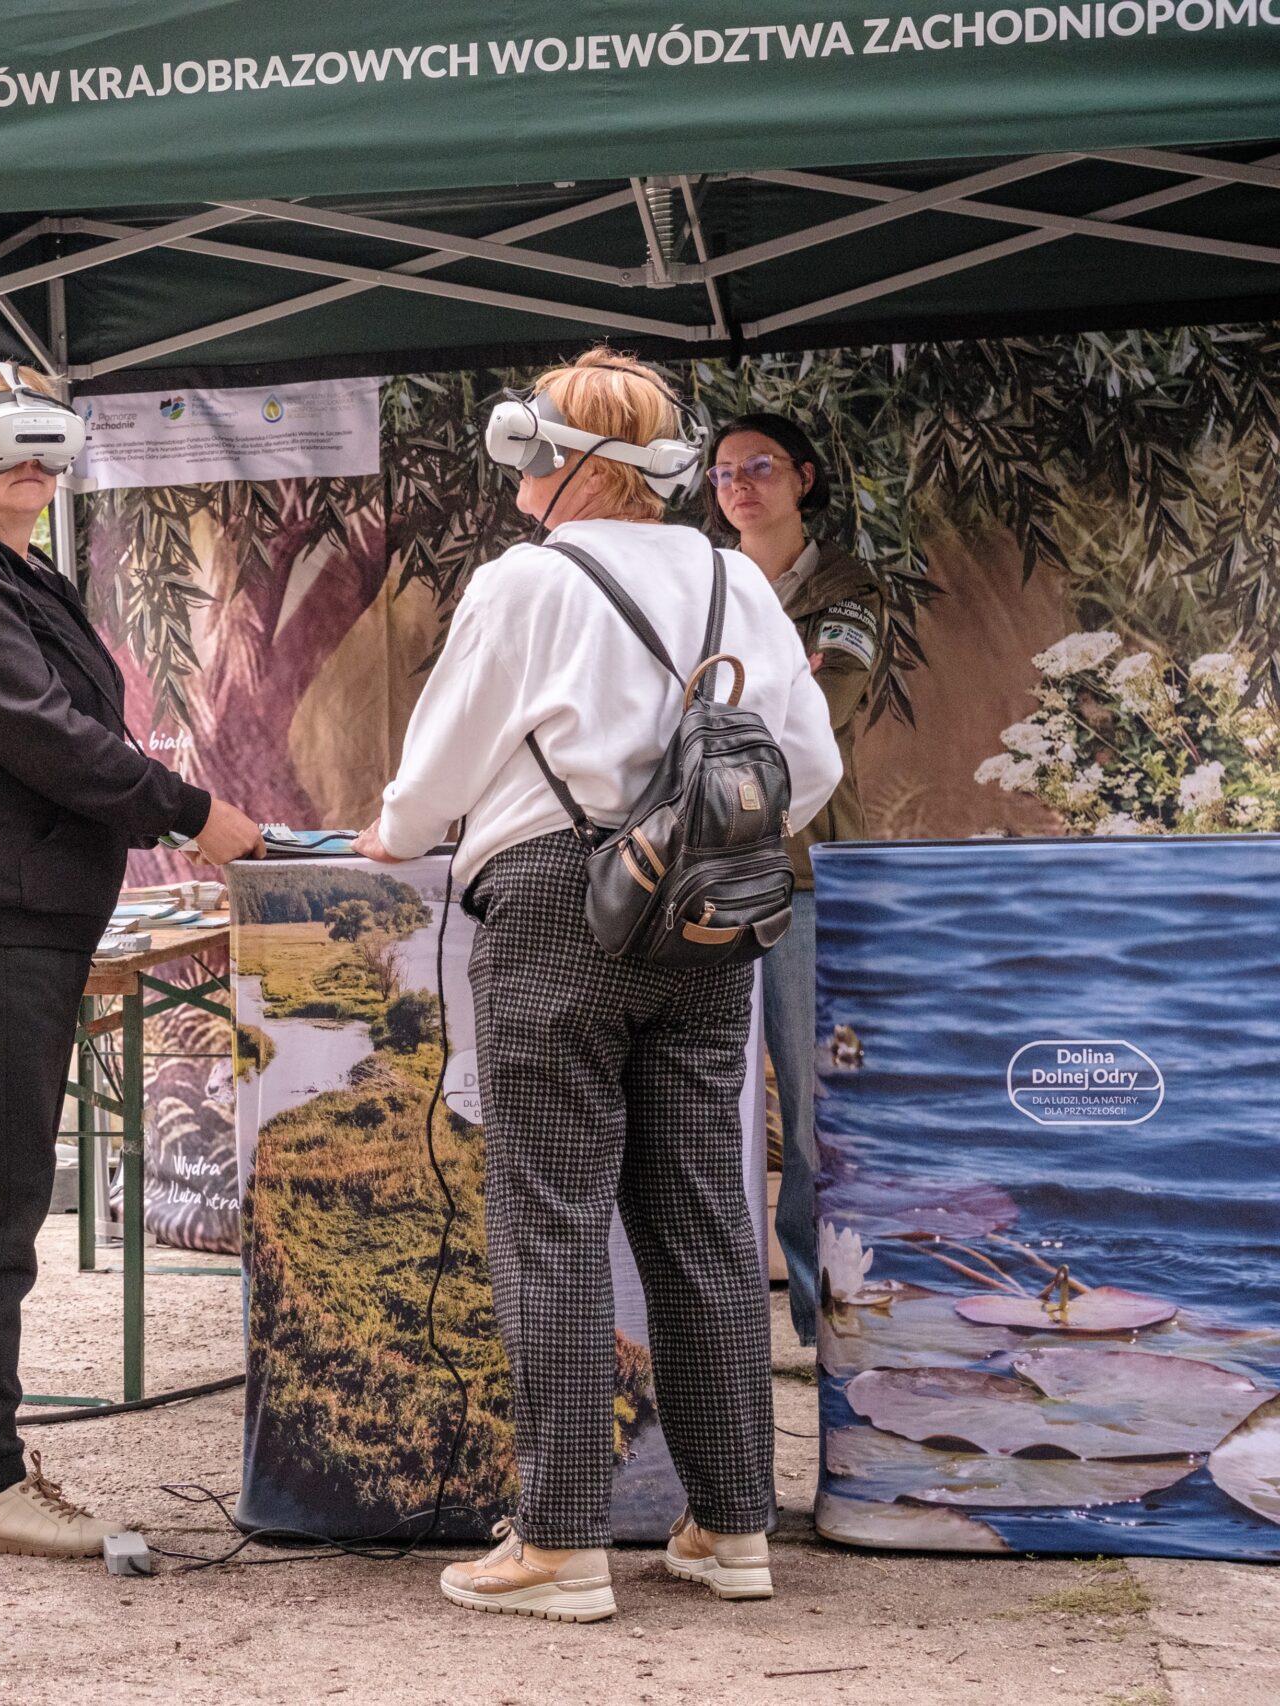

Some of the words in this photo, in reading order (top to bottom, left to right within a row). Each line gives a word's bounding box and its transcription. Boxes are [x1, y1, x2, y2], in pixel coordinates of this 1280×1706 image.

[69, 42, 479, 102] KRAJOBRAZOWYCH
[487, 21, 855, 75] WOJEWÓDZTWA
[98, 412, 137, 421] Pomorze
[91, 421, 135, 431] Zachodnie
[149, 731, 193, 751] biała
[1056, 1048, 1115, 1064] Dolina
[1031, 1068, 1090, 1090] Dolnej
[1092, 1068, 1139, 1090] Odry
[1032, 1096, 1051, 1104] DLA
[1051, 1096, 1081, 1106] LUDZI,
[1081, 1096, 1100, 1104] DLA
[1101, 1096, 1140, 1105] NATURY,
[1044, 1107, 1063, 1115] DLA
[1064, 1105, 1127, 1115] PRZYSZŁOŚCI!
[173, 1155, 221, 1180] Wydra
